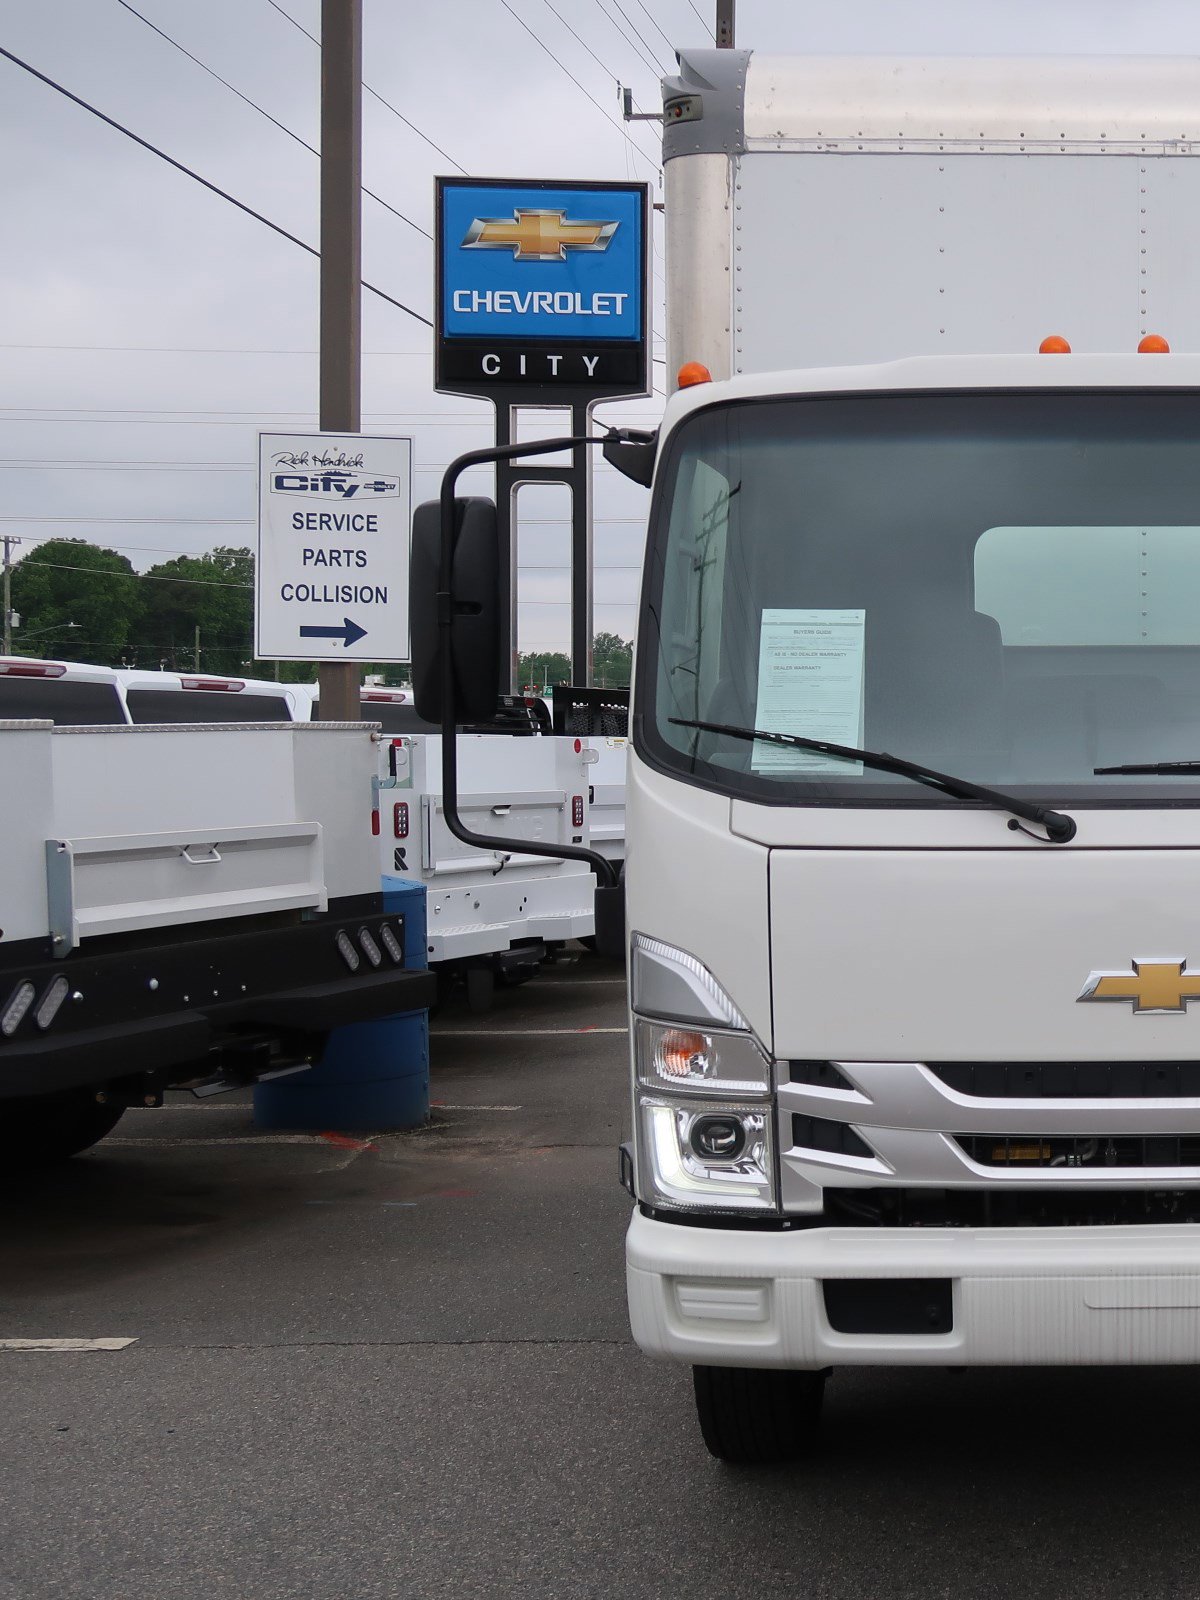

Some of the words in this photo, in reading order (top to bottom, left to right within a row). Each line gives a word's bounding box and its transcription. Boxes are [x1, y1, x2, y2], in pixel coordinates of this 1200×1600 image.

[453, 290, 628, 315] CHEVROLET
[481, 353, 600, 377] CITY
[270, 451, 309, 469] Rick
[311, 449, 364, 469] Hendrick
[274, 475, 360, 498] City
[292, 512, 379, 533] SERVICE
[302, 548, 368, 568] PARTS
[281, 583, 388, 604] COLLISION
